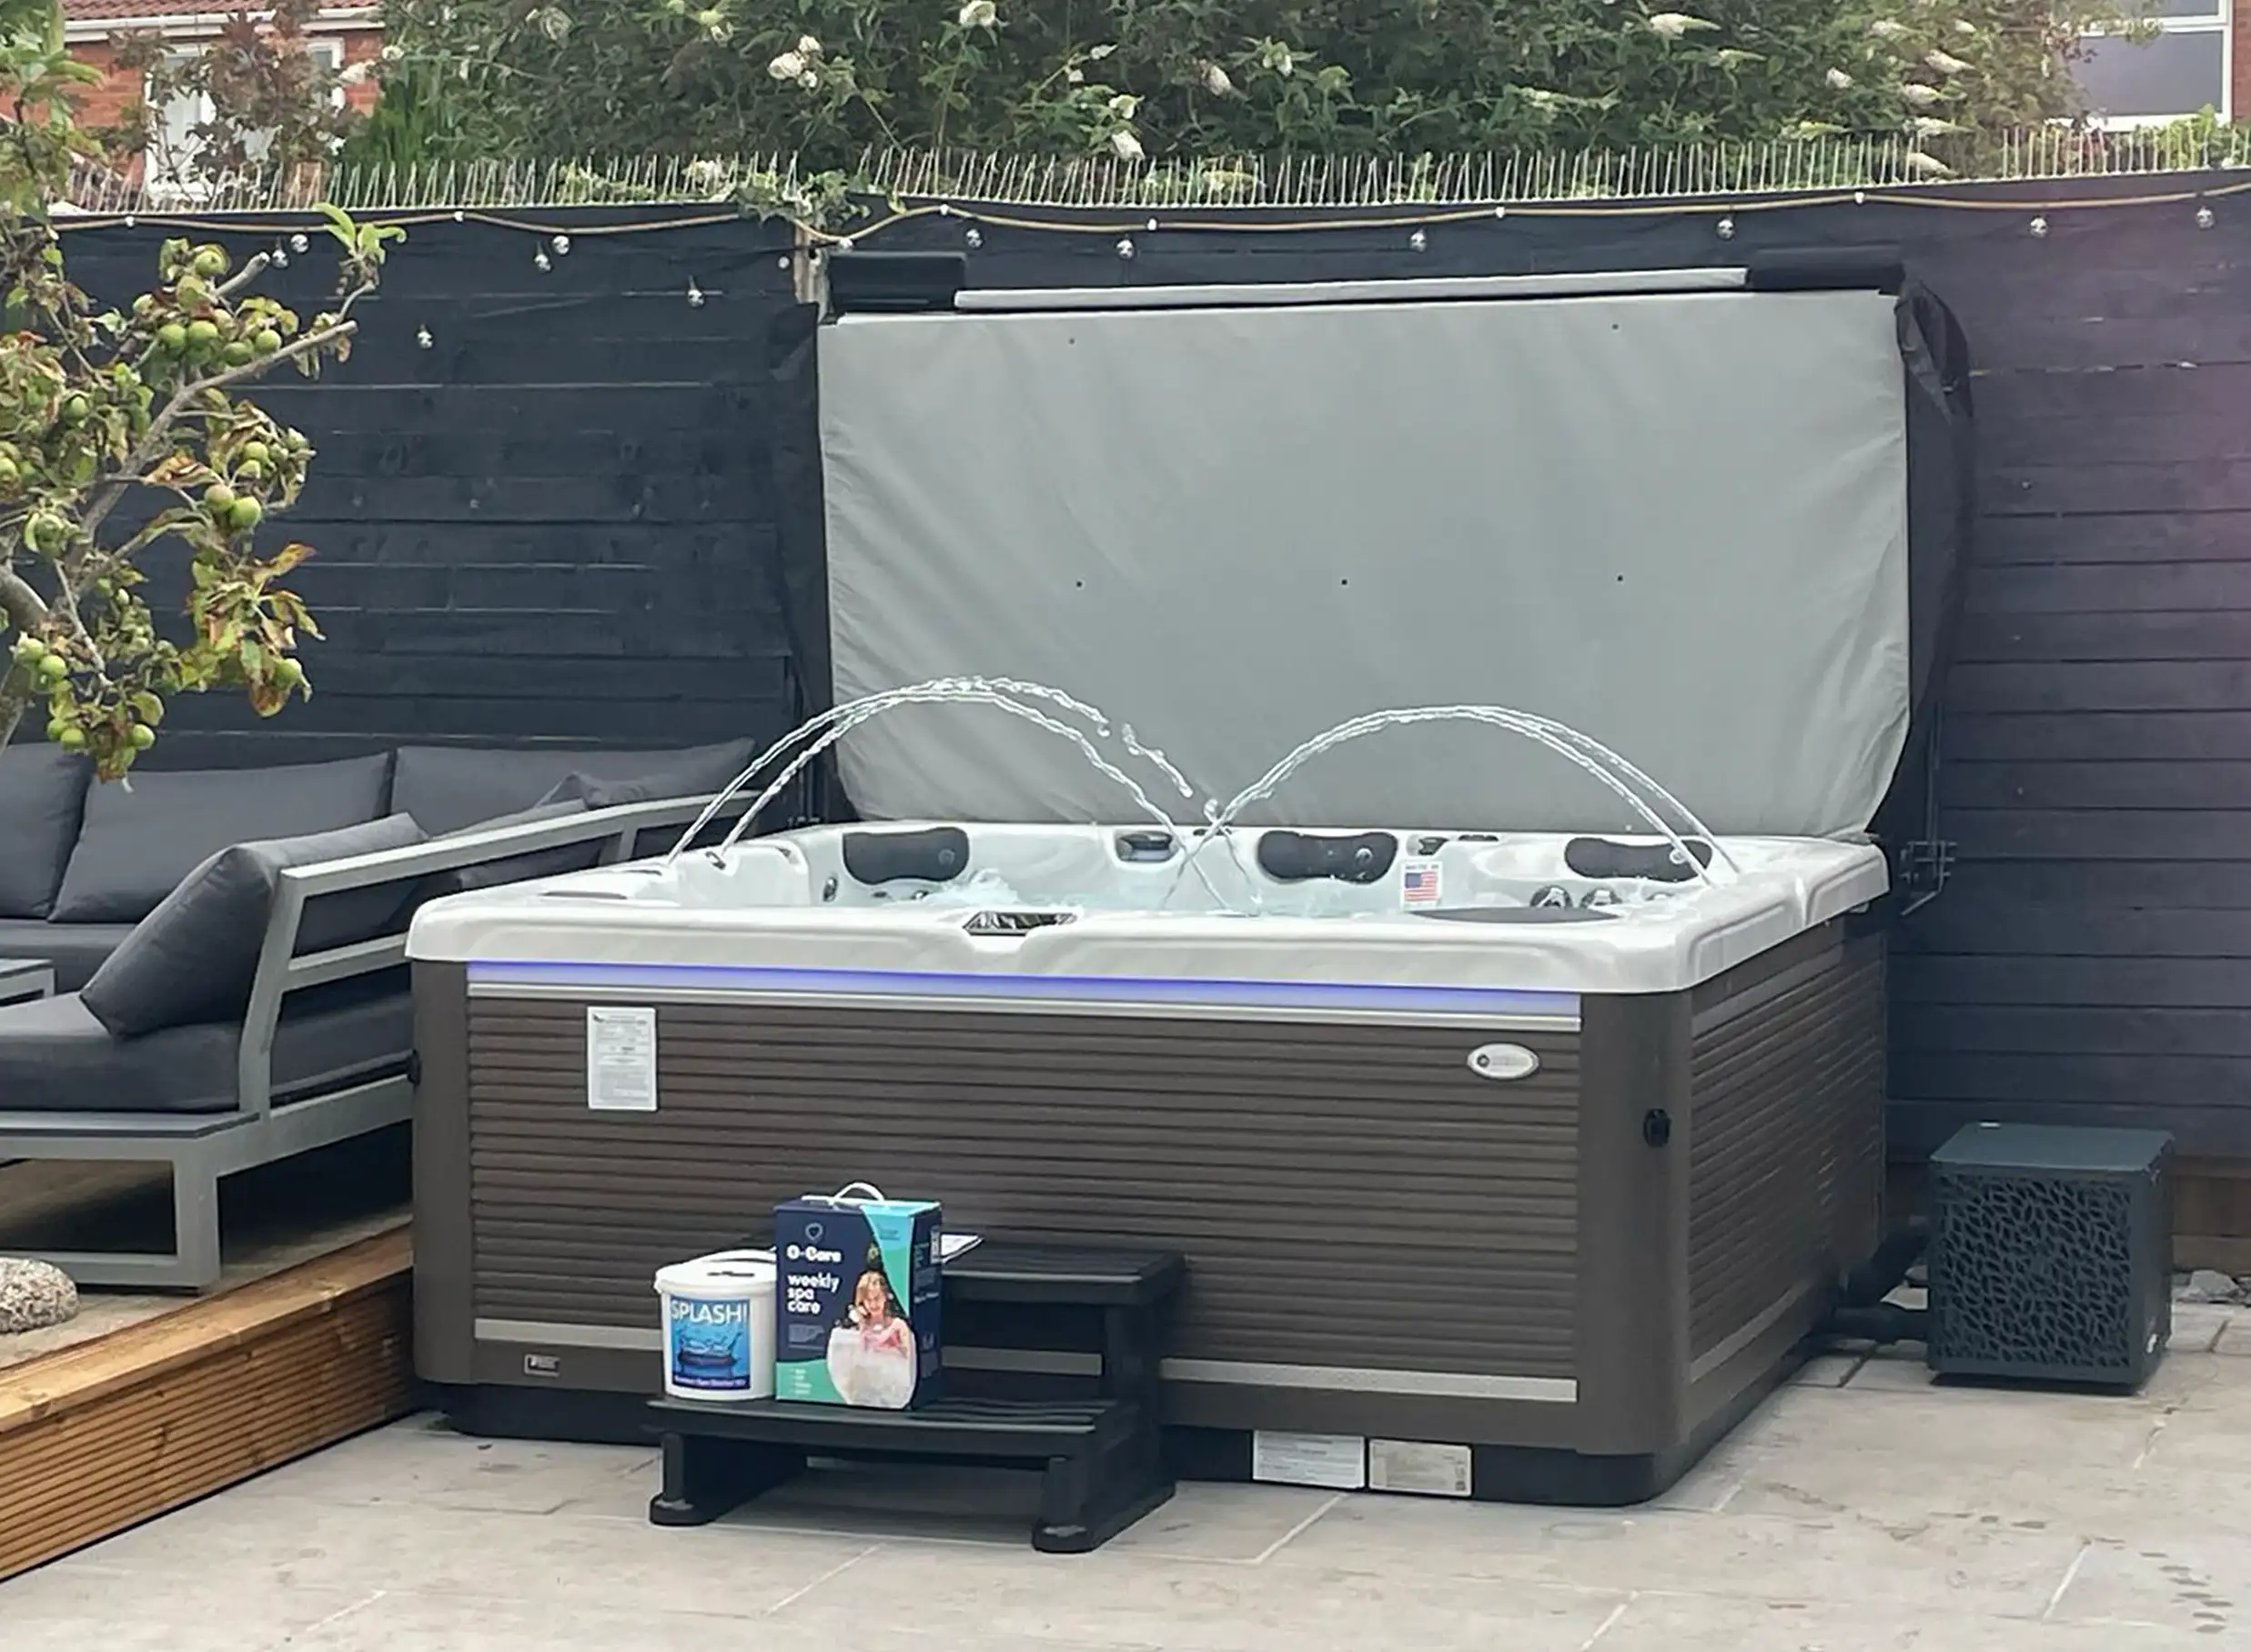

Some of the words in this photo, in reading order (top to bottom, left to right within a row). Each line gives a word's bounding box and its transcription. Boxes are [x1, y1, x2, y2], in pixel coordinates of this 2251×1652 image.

[787, 1272, 840, 1294] weekly
[787, 1287, 814, 1302] spa
[787, 1301, 821, 1315] care
